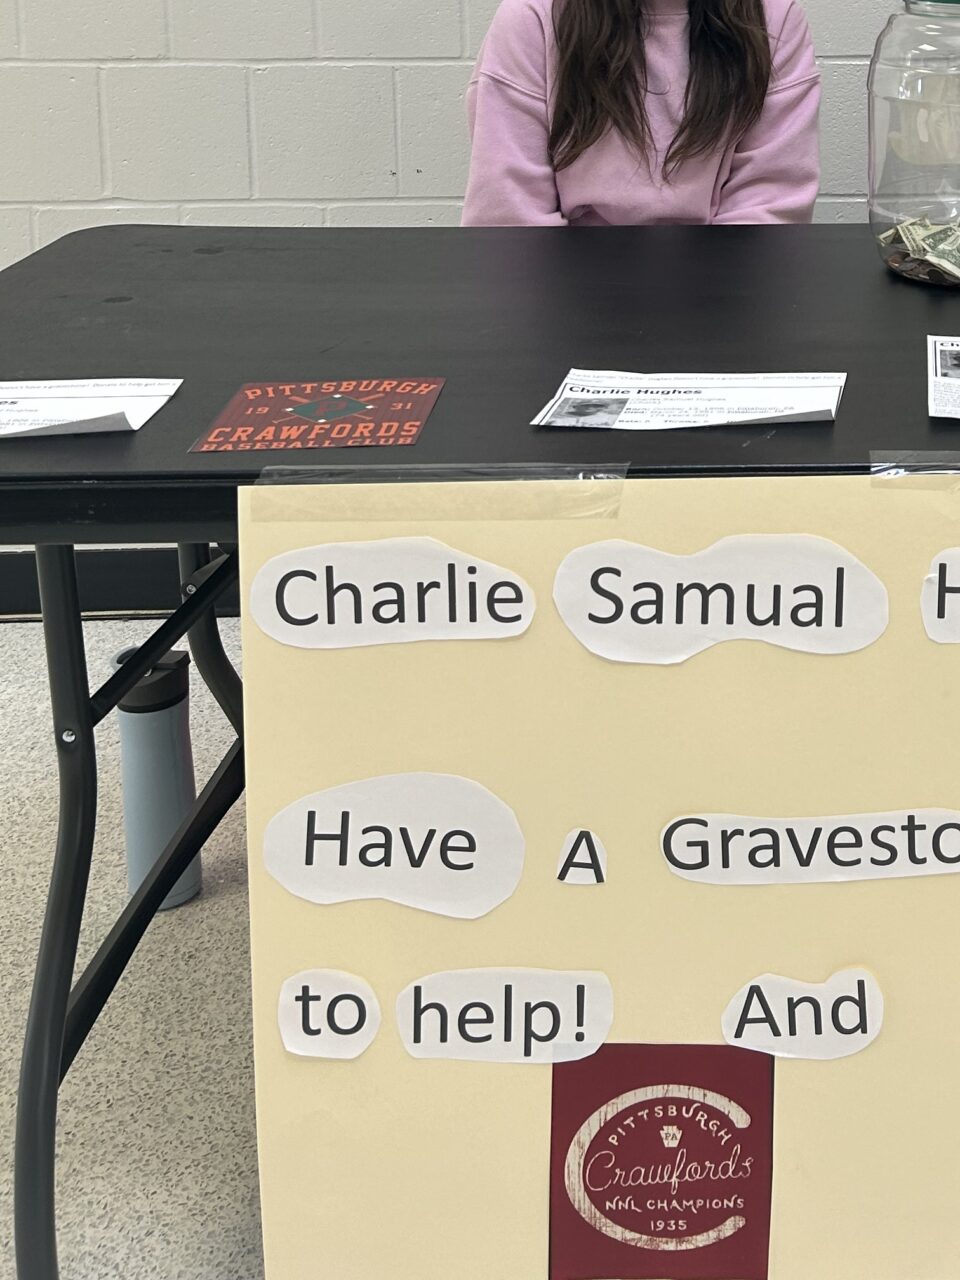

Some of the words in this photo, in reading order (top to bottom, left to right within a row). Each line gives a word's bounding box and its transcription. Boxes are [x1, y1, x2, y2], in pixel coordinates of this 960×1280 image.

[245, 380, 438, 400] PITTSBURGH
[569, 386, 631, 395] Charlie
[245, 407, 269, 415] 19
[207, 421, 421, 442] CRAWFORDS
[201, 440, 335, 451] BASEBALL
[348, 437, 416, 446] CLUB
[275, 562, 524, 627] Charlie
[588, 566, 845, 628] Samual
[304, 810, 477, 871] Have
[557, 830, 605, 883] A
[295, 985, 367, 1037] to
[412, 984, 586, 1057] help!
[734, 980, 869, 1040] And
[608, 1103, 732, 1146] PITTSBURGH
[664, 1133, 678, 1141] PA
[586, 1144, 755, 1195] Crawfords
[605, 1195, 643, 1212] NNL
[647, 1194, 745, 1214] CHAMPIONS
[650, 1220, 687, 1231] 1935
